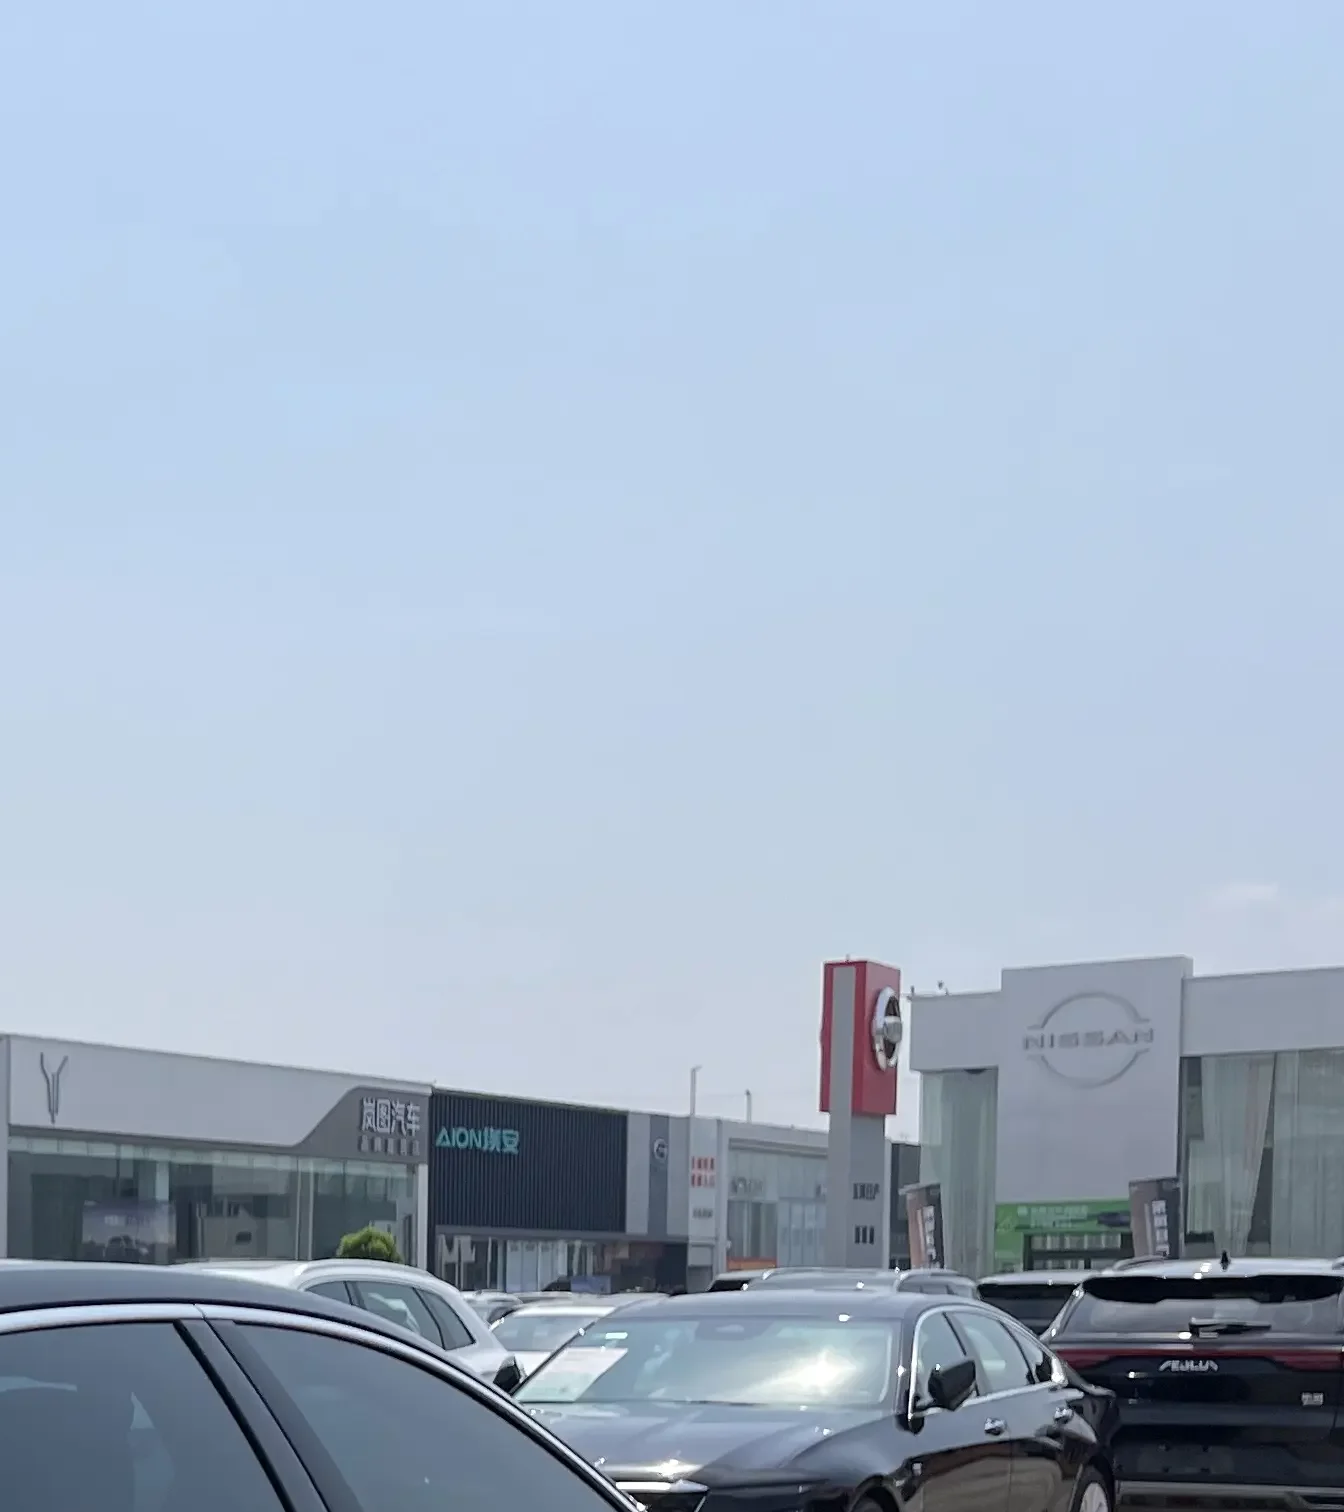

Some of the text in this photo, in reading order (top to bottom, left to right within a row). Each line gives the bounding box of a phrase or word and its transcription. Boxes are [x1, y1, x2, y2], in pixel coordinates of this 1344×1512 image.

[1023, 1027, 1155, 1051] NISSAN
[362, 1097, 421, 1137] 岚图汽车
